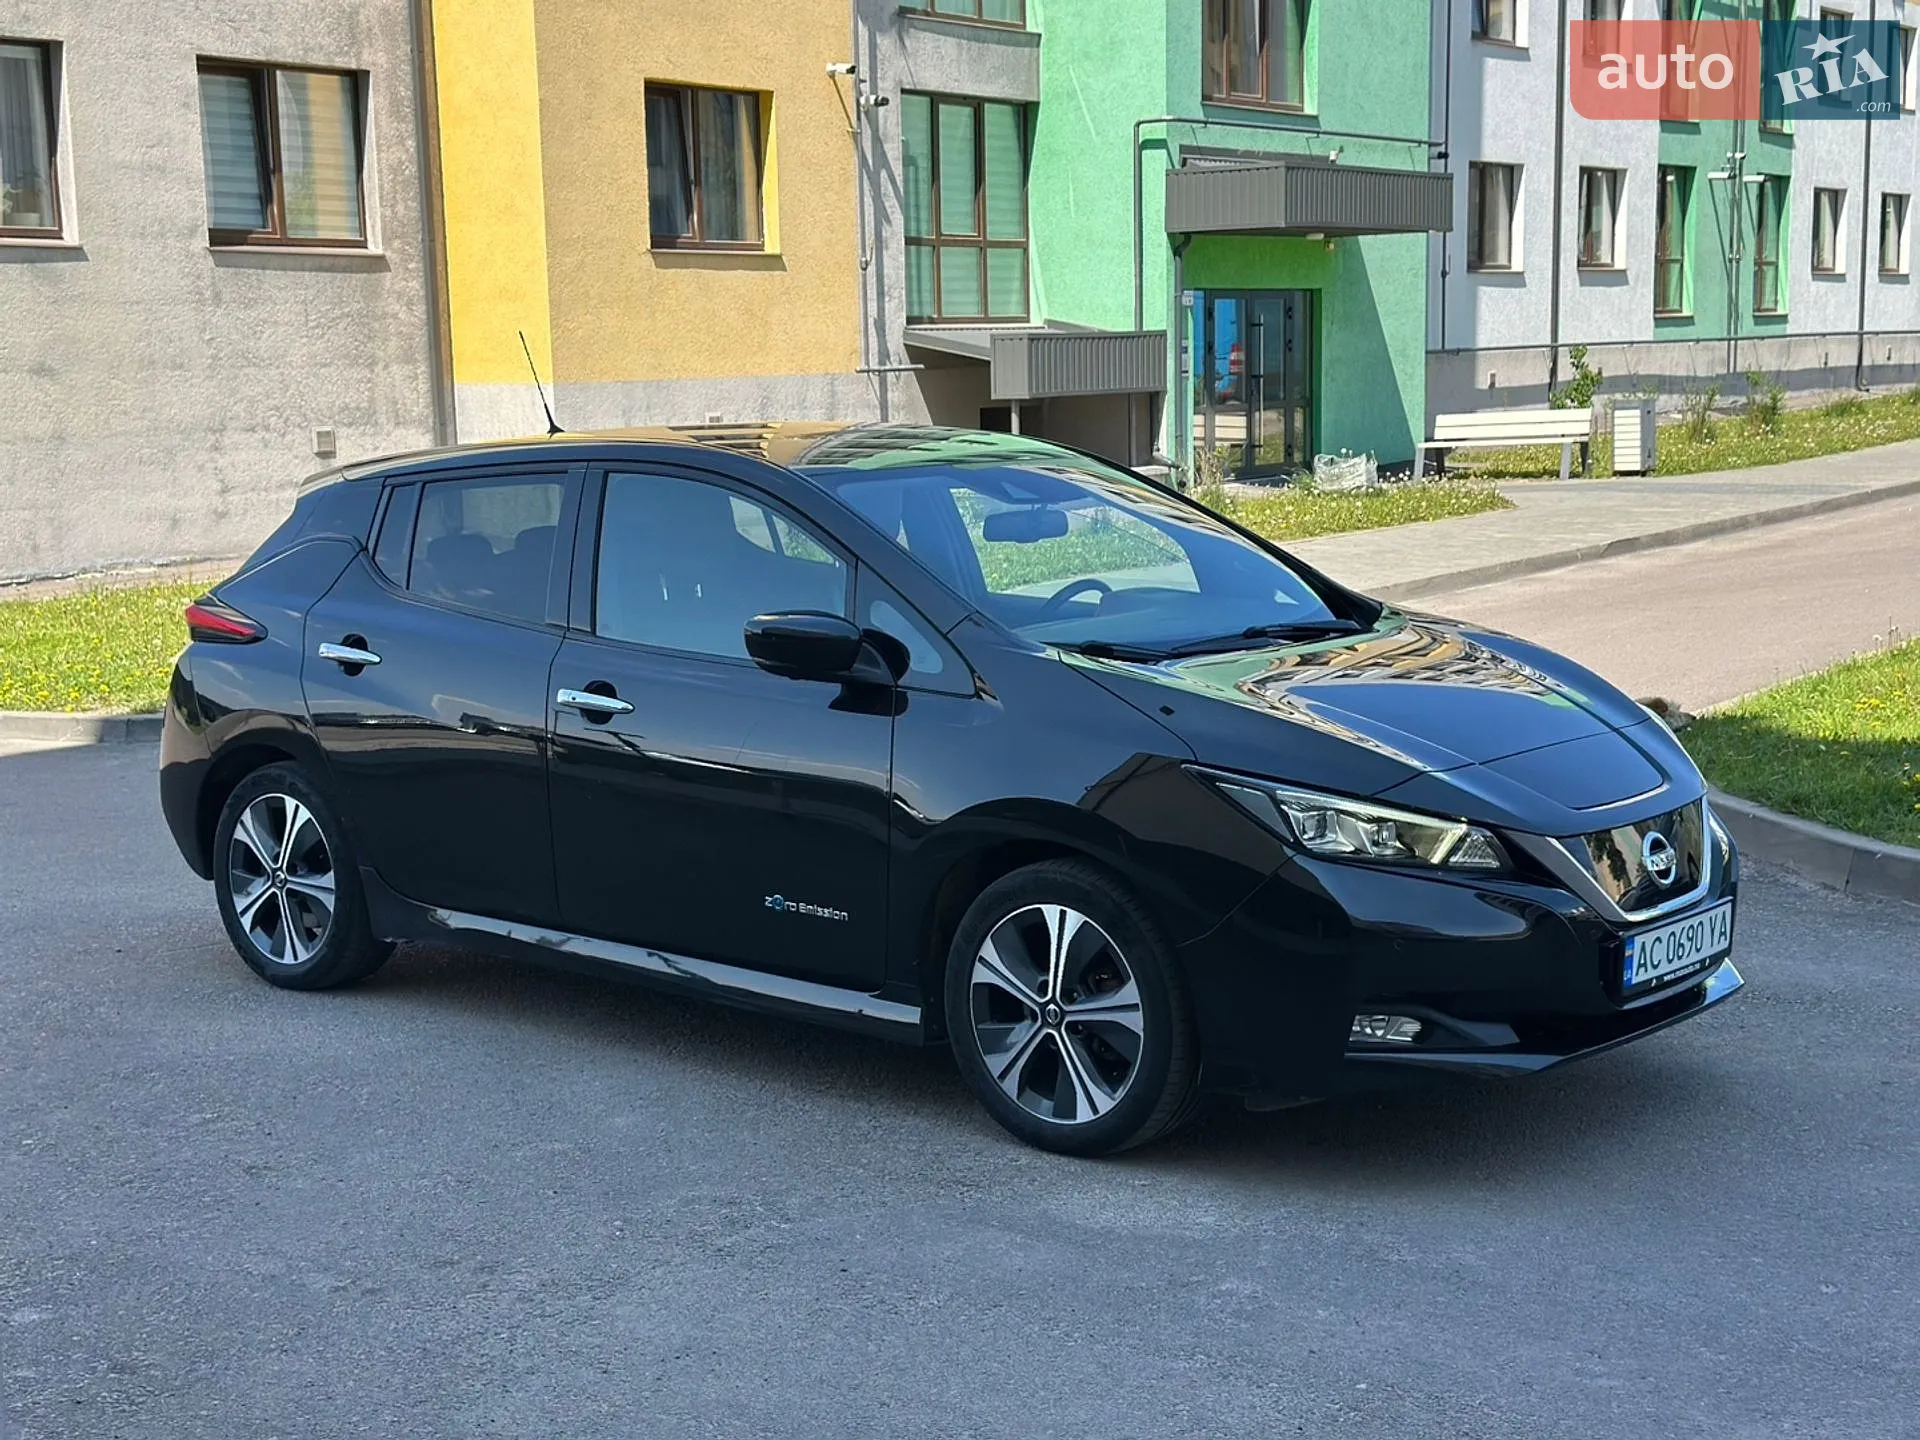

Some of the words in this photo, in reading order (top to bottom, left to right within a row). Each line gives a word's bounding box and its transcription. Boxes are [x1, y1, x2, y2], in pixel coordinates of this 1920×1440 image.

[1635, 936, 1663, 977] AC
[1666, 920, 1704, 965] 0690
[1709, 910, 1728, 948] YA
